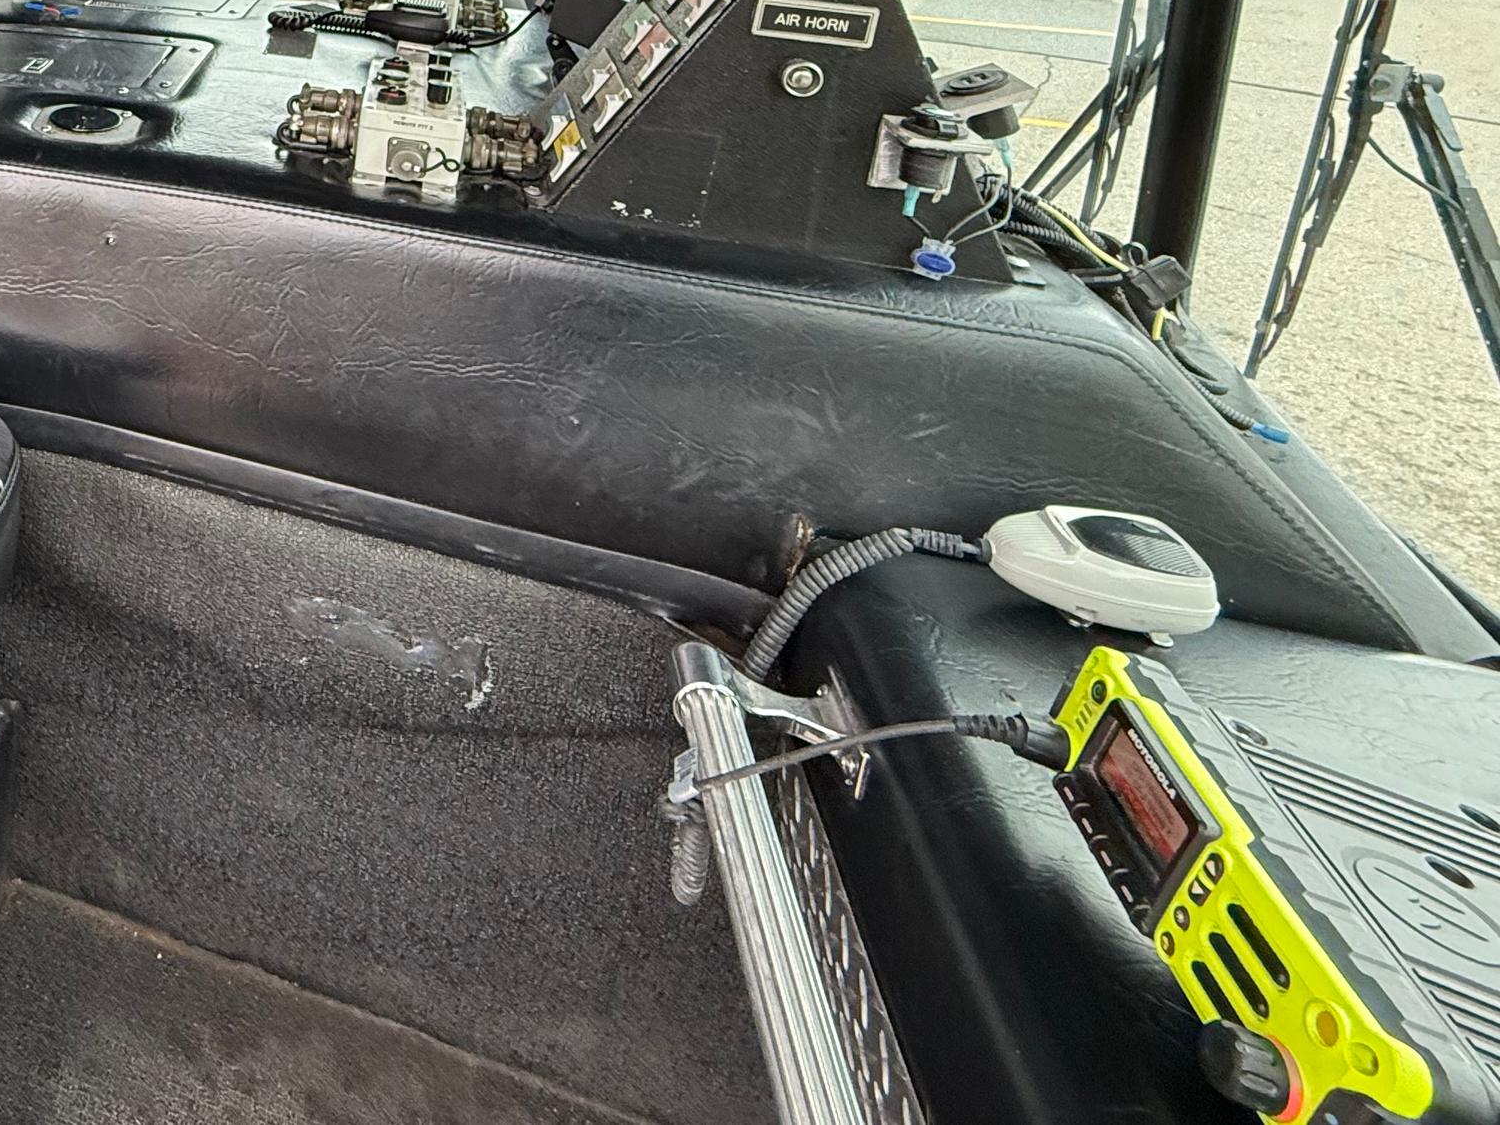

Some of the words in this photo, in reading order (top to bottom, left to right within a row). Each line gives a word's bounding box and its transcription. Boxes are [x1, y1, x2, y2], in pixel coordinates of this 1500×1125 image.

[774, 13, 801, 27] AIR
[804, 16, 850, 33] HORN
[1127, 728, 1177, 800] MOTOROLA
